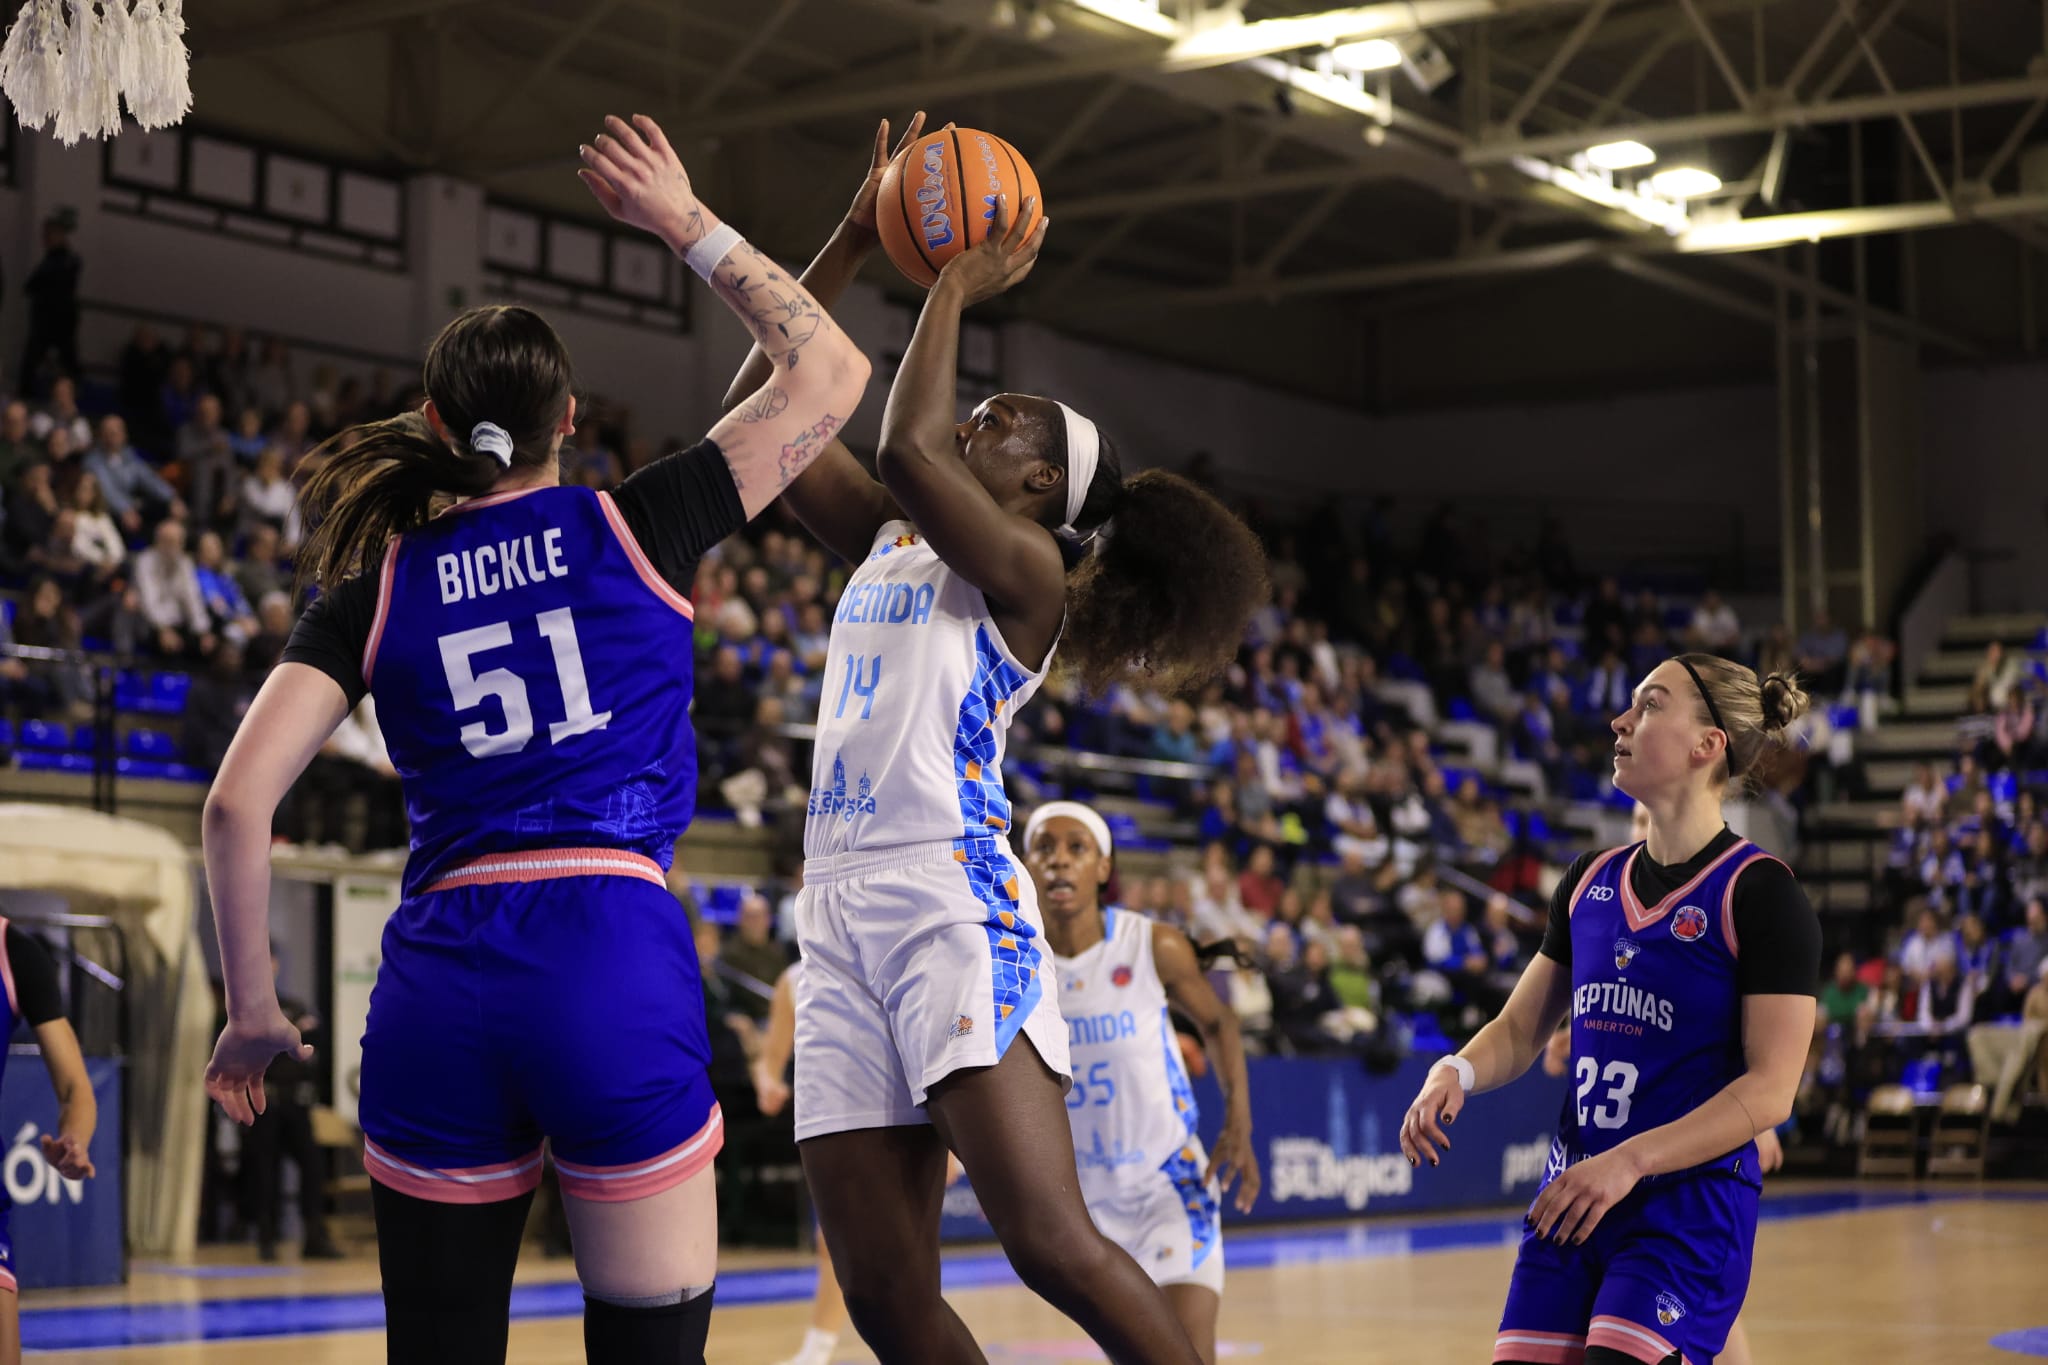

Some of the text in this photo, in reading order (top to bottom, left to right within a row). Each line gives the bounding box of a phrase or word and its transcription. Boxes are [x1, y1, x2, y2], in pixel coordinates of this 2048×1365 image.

[916, 141, 954, 251] Wilson
[437, 527, 568, 604] BICKLE
[437, 606, 612, 759] 51
[835, 654, 881, 719] 14
[1573, 976, 1674, 1032] NEPTŪNAS
[1583, 1019, 1643, 1037] AMBERTON
[1067, 1061, 1115, 1109] 55
[1576, 1056, 1639, 1129] 23
